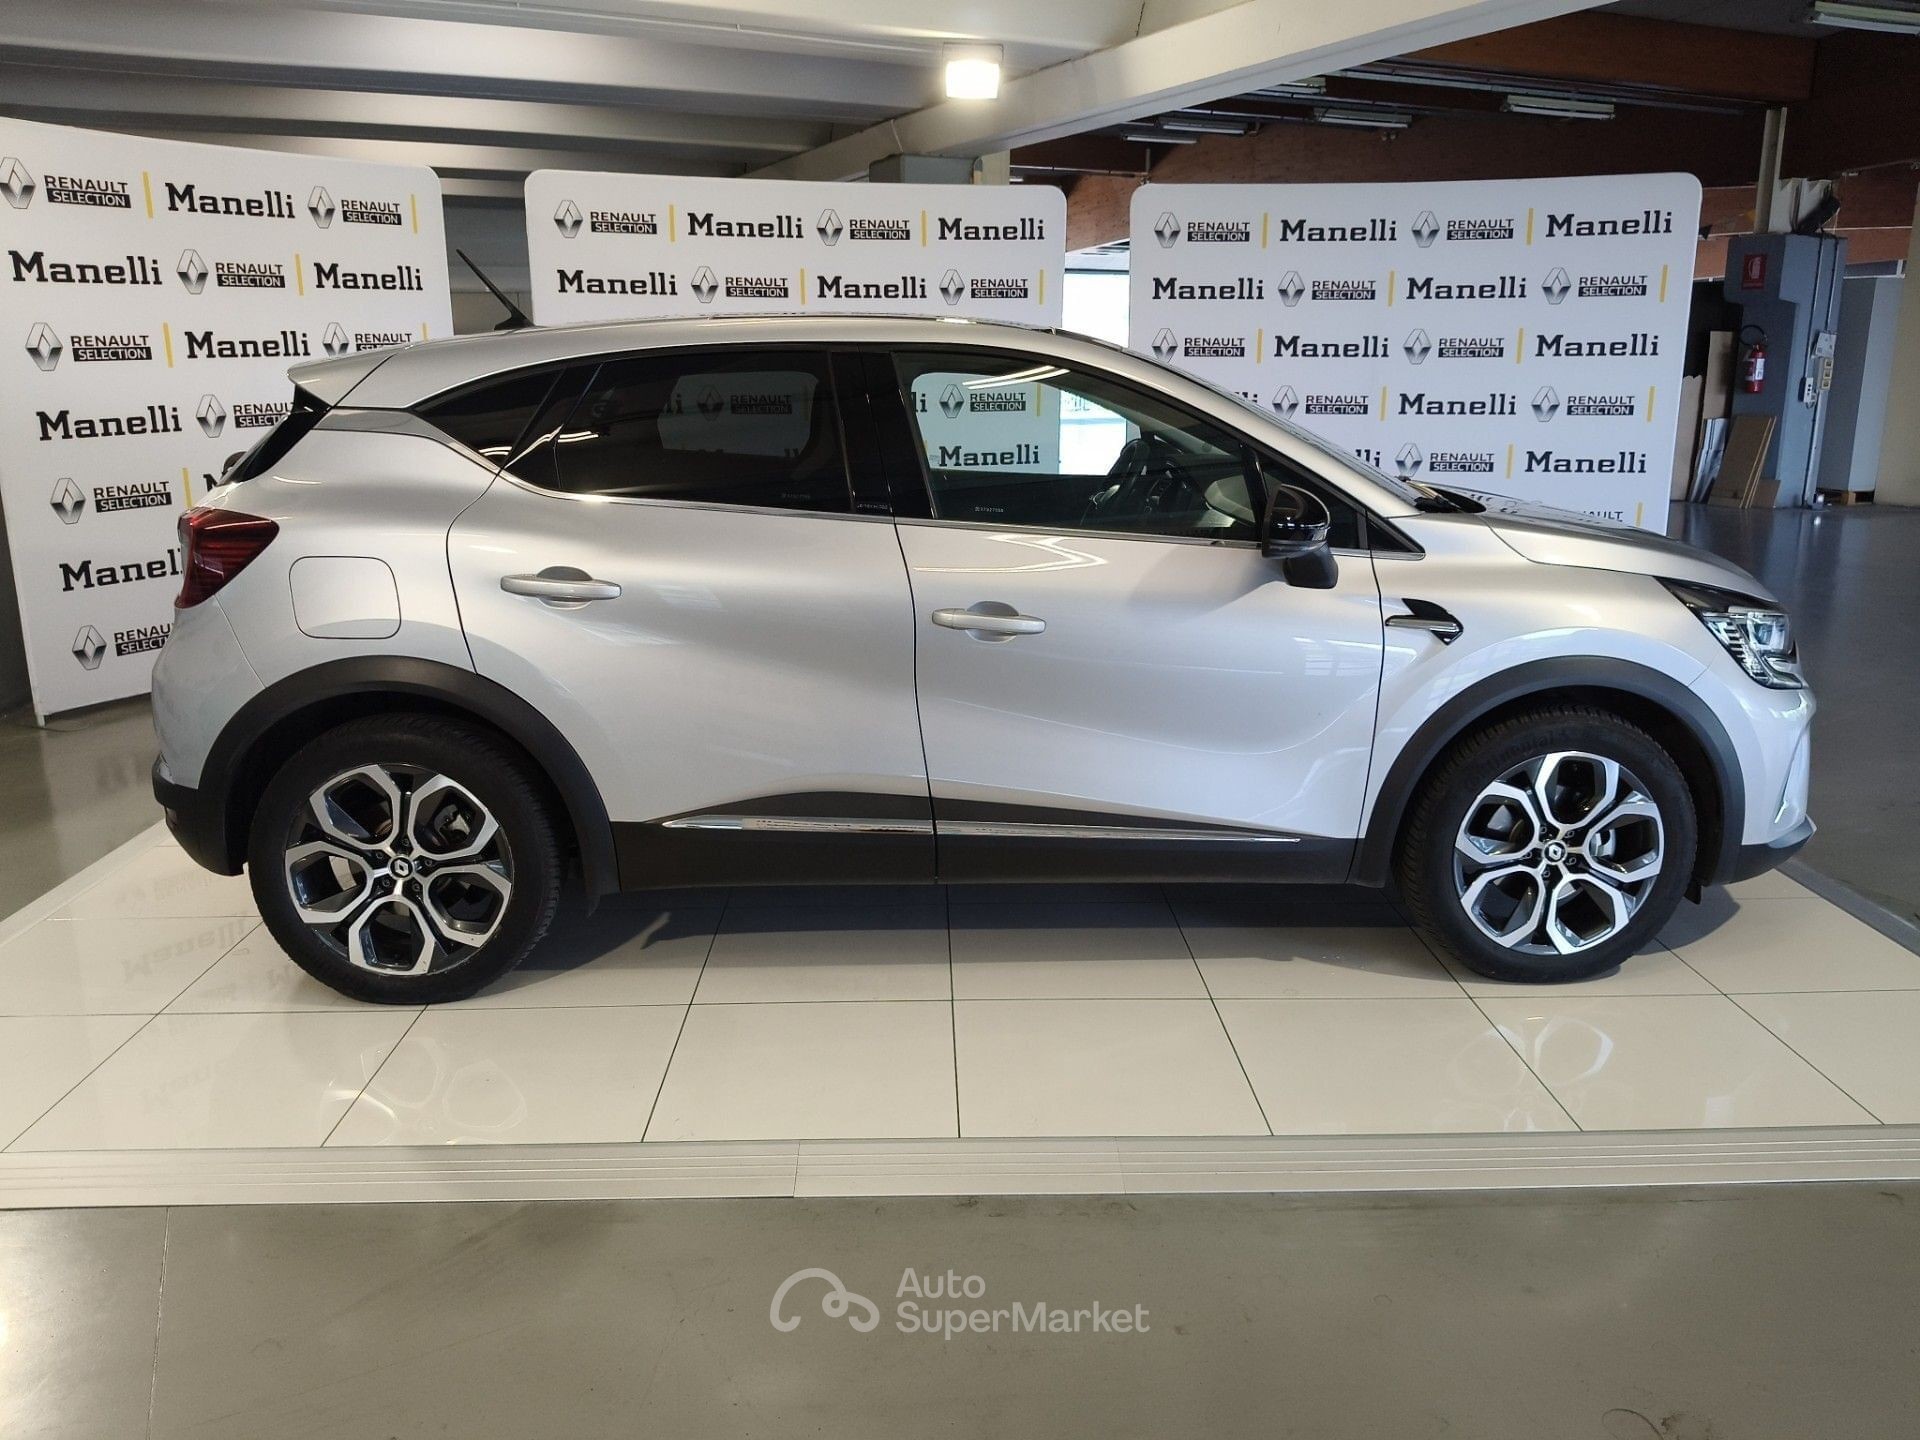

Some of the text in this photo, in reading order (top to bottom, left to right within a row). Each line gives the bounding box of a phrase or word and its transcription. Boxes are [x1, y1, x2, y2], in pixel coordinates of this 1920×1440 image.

[44, 175, 128, 194] RENAULT
[52, 191, 126, 207] SELECTION
[165, 182, 296, 219] Manelli
[340, 199, 400, 213] RENAULT
[346, 212, 399, 225] SELECTION
[590, 211, 657, 224] RENAULT
[1546, 210, 1673, 237] Manelli
[594, 222, 653, 234] SELECTION
[688, 212, 804, 239] Manelli
[850, 219, 910, 229] RENAULT
[938, 217, 1045, 241] Manelli
[1188, 222, 1250, 232] RENAULT
[1280, 218, 1397, 242] Manelli
[1447, 219, 1514, 230] RENAULT
[854, 230, 907, 240] SELECTION
[1191, 232, 1246, 241] SELECTION
[1450, 229, 1510, 240] SELECTION
[8, 250, 163, 286] Manelli
[215, 262, 283, 275] RENAULT
[221, 275, 281, 287] SELECTION
[313, 262, 424, 291] Manelli
[557, 269, 678, 296] Manelli
[725, 276, 788, 287] RENAULT
[1579, 275, 1647, 286] RENAULT
[817, 275, 927, 299] Manelli
[971, 278, 1028, 288] RENAULT
[1152, 277, 1265, 300] Manelli
[1312, 280, 1376, 290] RENAULT
[1407, 276, 1527, 300] Manelli
[729, 287, 784, 297] SELECTION
[975, 288, 1025, 298] SELECTION
[1315, 290, 1372, 300] SELECTION
[1582, 286, 1642, 296] SELECTION
[70, 334, 149, 347] RENAULT
[355, 333, 412, 343] RENAULT
[1185, 338, 1245, 347] RENAULT
[1439, 338, 1504, 348] RENAULT
[185, 330, 311, 359] Manelli
[1274, 335, 1389, 358] Manelli
[1535, 334, 1659, 357] Manelli
[77, 347, 148, 360] SELECTION
[1188, 347, 1241, 357] SELECTION
[1443, 347, 1501, 357] SELECTION
[731, 395, 793, 404] RENAULT
[970, 392, 1026, 401] RENAULT
[1306, 395, 1369, 404] RENAULT
[1567, 396, 1635, 405] RENAULT
[974, 402, 1023, 411] SELECTION
[1309, 404, 1364, 414] SELECTION
[1398, 393, 1517, 416] Manelli
[1571, 405, 1631, 416] SELECTION
[36, 405, 183, 441] Manelli
[240, 415, 281, 427] SELECT
[939, 444, 1040, 467] Manelli
[1430, 453, 1494, 462] RENAULT
[1433, 462, 1490, 472] SELECTION
[1525, 451, 1647, 474] Manelli
[93, 481, 170, 499] RENAULT
[100, 495, 168, 511] SELECTION
[59, 548, 182, 592] Manel
[114, 623, 170, 643] RENAU
[121, 637, 165, 654] SELECT
